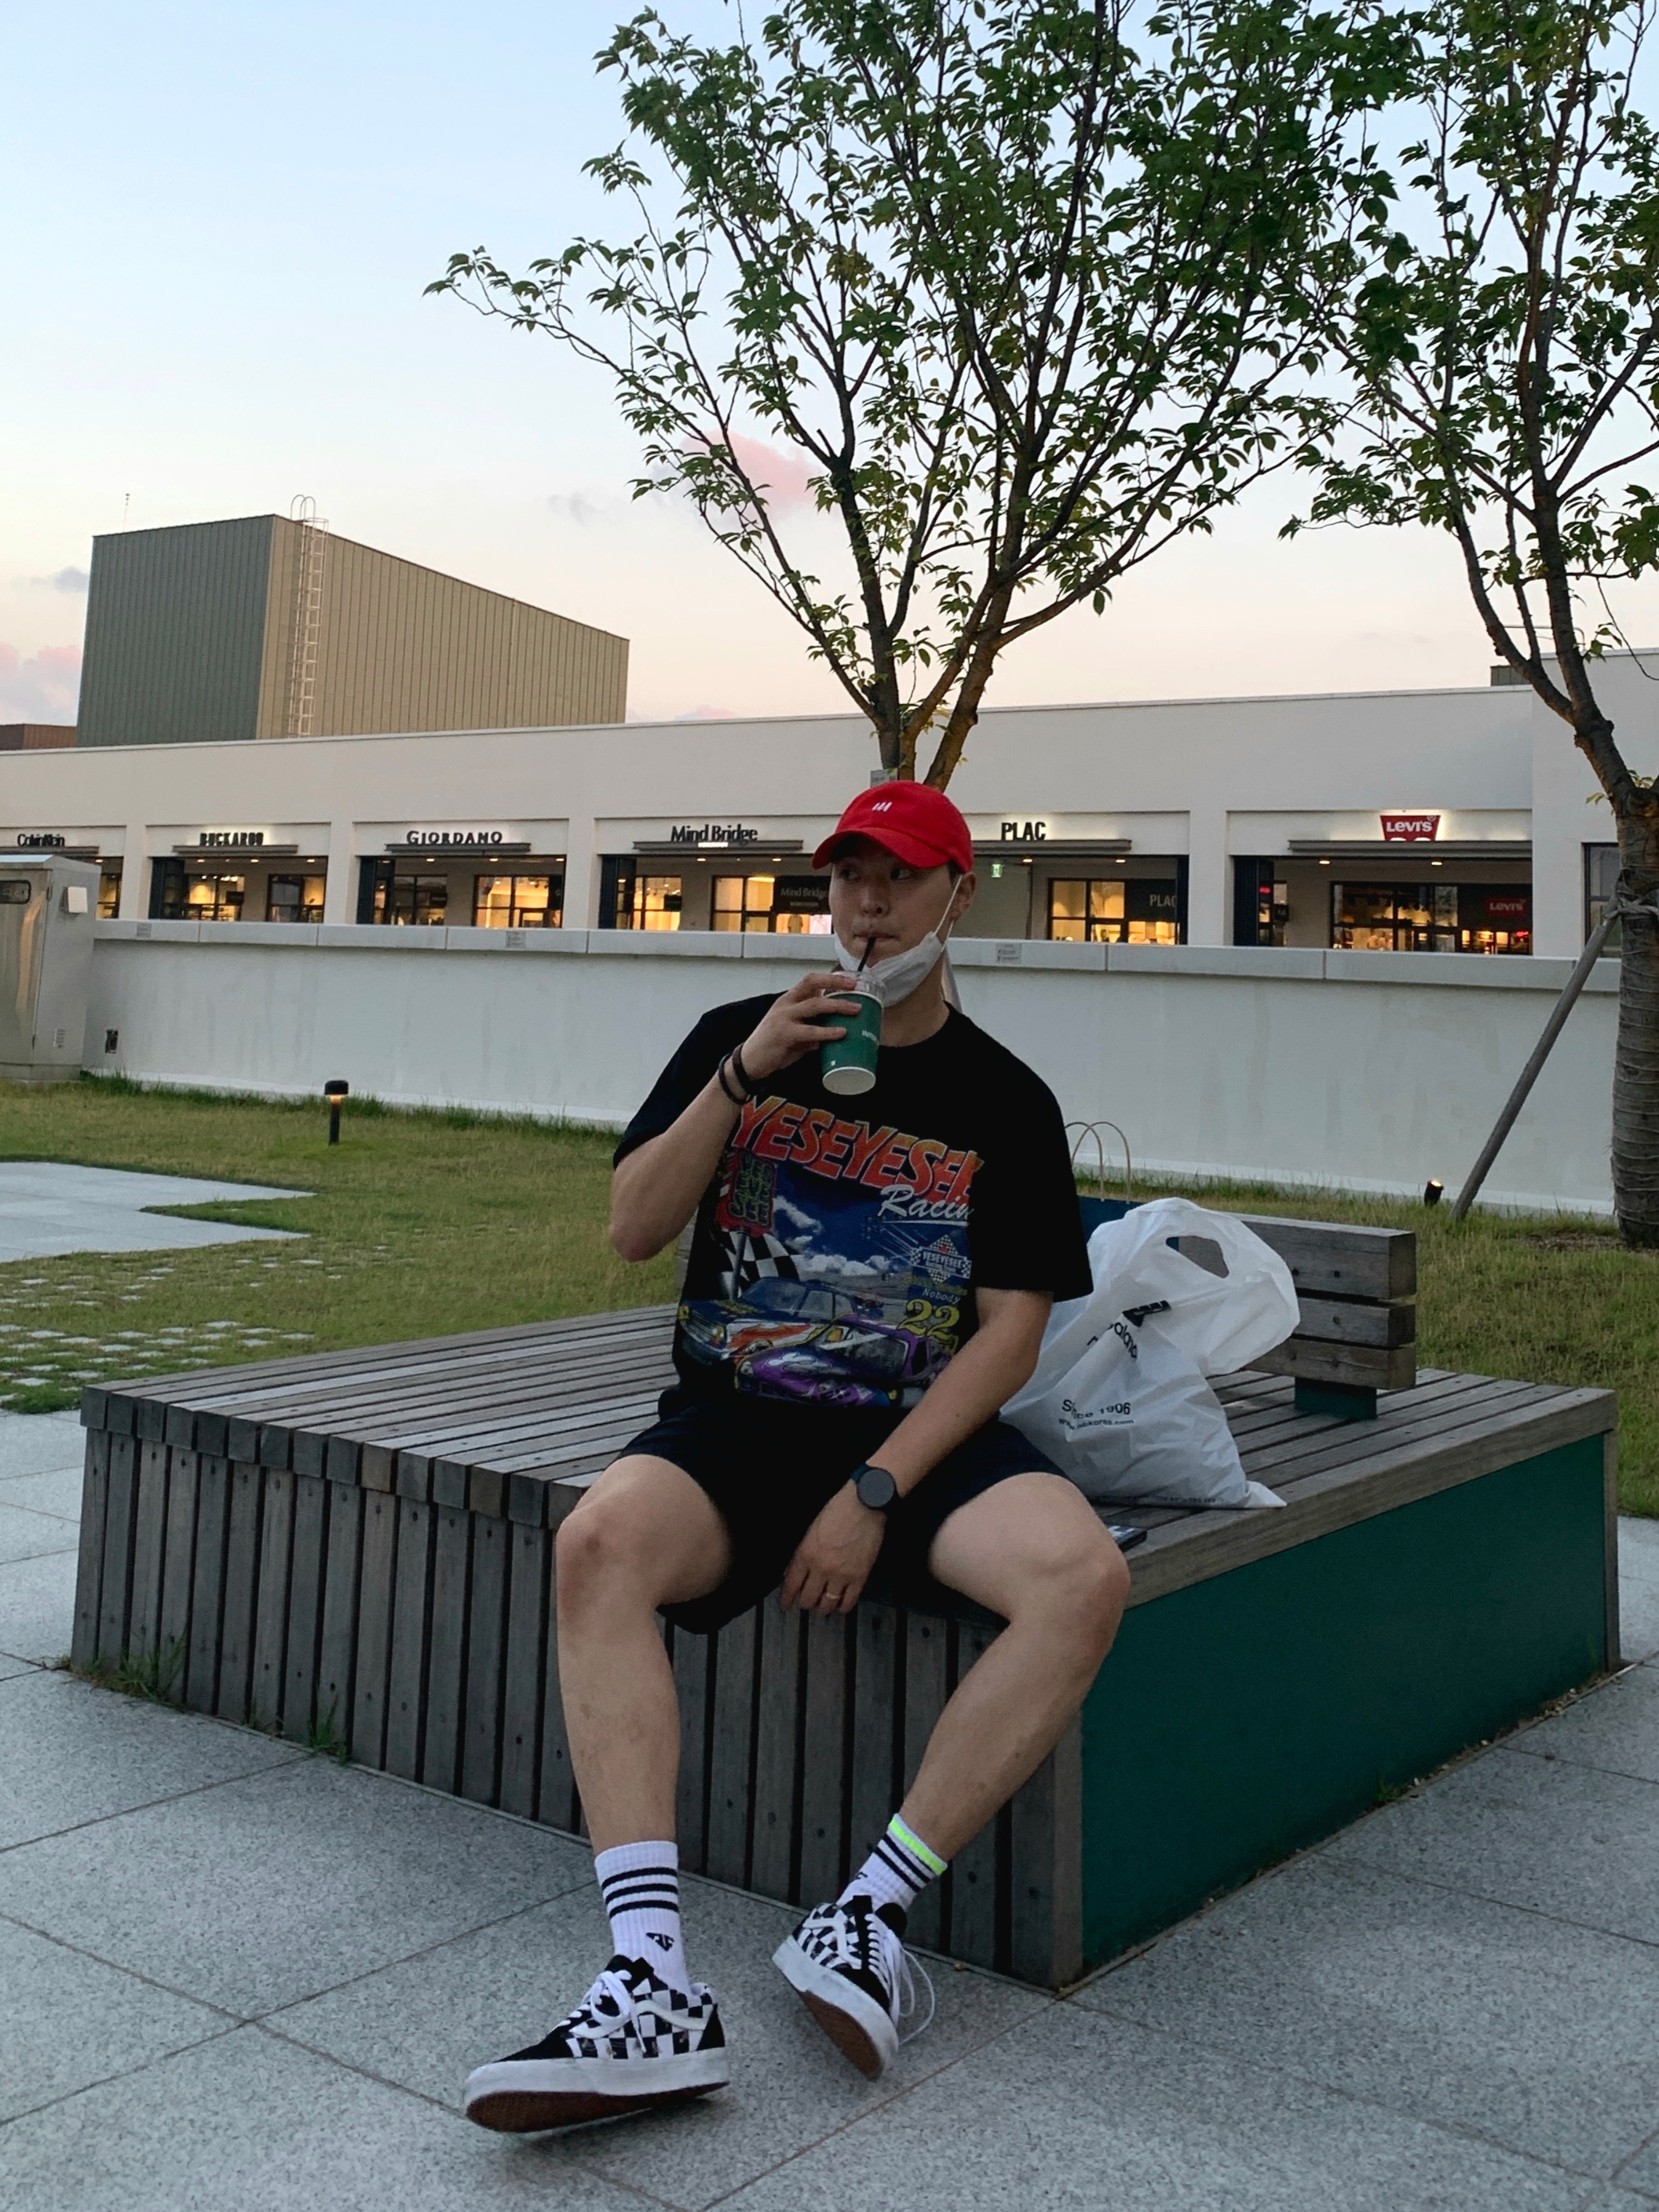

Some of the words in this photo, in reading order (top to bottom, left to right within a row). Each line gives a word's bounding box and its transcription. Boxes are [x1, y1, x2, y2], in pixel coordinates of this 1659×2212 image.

[407, 830, 502, 845] GIORDANO
[671, 824, 708, 842] Mind
[711, 824, 758, 845] Bridge
[1001, 822, 1046, 841] PLAC
[780, 887, 802, 896] Mind
[922, 1287, 961, 1305] Nobody
[897, 1298, 960, 1342] 22
[1098, 1402, 1131, 1414] 1906
